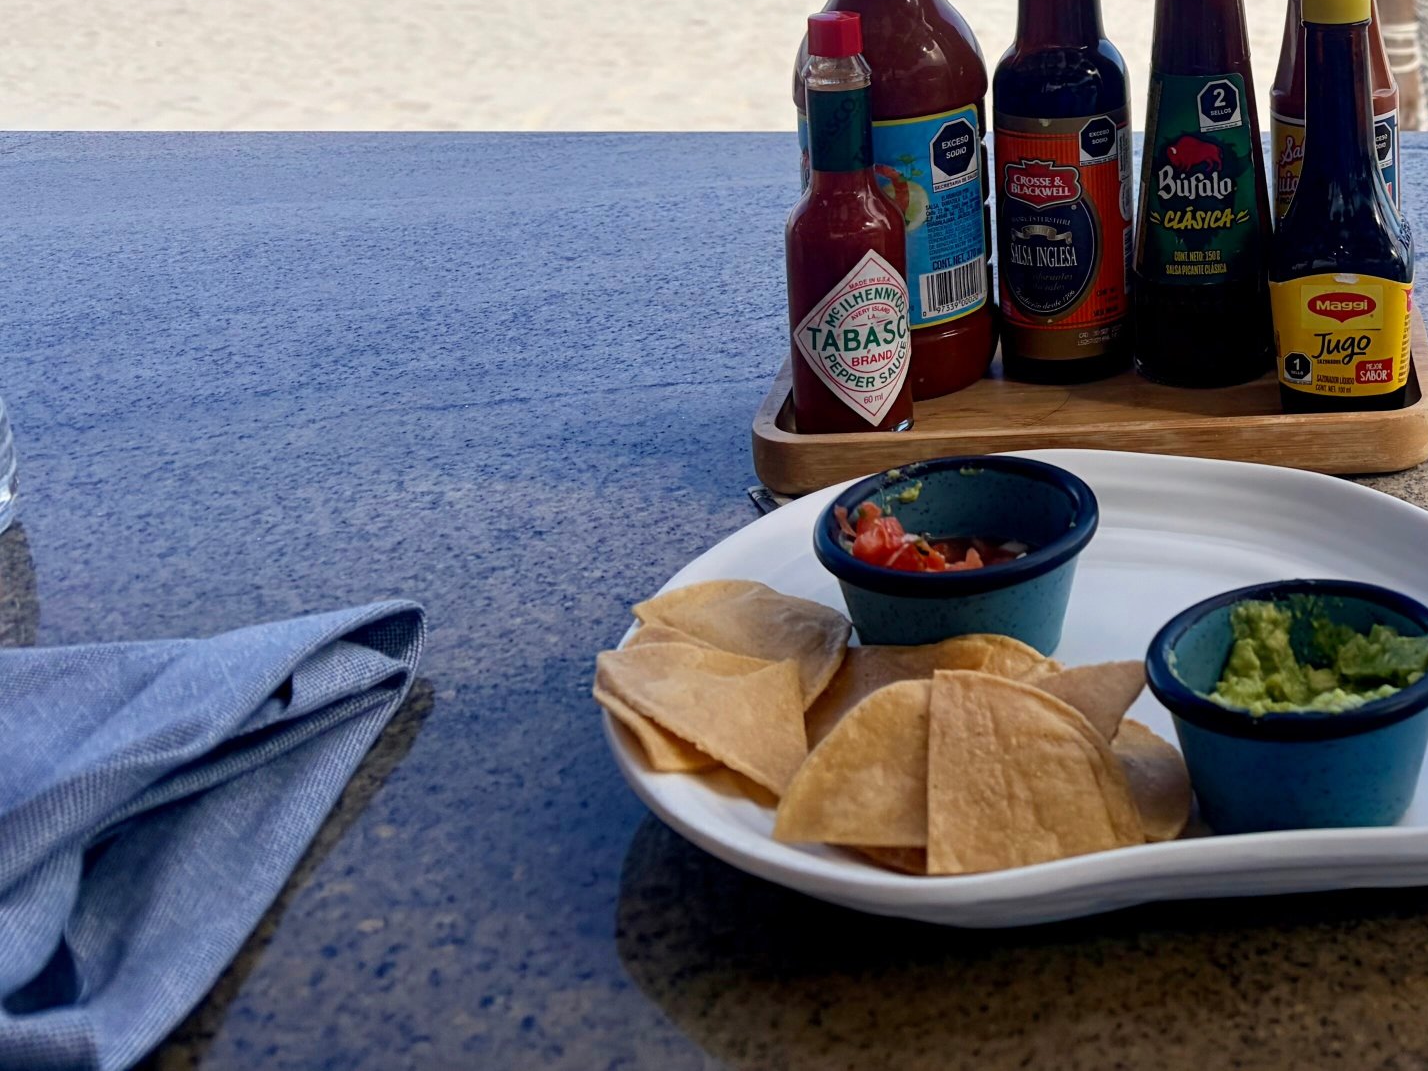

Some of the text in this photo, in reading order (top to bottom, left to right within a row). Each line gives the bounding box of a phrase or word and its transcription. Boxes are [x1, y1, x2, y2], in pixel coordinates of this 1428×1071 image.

[1213, 88, 1226, 107] 2
[1210, 108, 1232, 116] SELLOS
[1088, 129, 1110, 137] EXCESO
[1375, 134, 1388, 142] CESO
[941, 134, 969, 149] EXCESO
[945, 147, 967, 159] SODIO
[1013, 174, 1067, 187] CROSSE &
[1158, 165, 1233, 200] Búfalo
[1011, 183, 1071, 198] BLACKWELL
[1164, 206, 1235, 230] CLÁSICA
[1010, 242, 1078, 267] SALSA INGLESA
[1166, 261, 1228, 276] SALSA PICANTE CLÁSICA
[848, 278, 868, 290] MADE
[1316, 299, 1369, 311] Maggi
[851, 305, 891, 321] AVERY ISLAND
[807, 314, 908, 352] TABASC
[1311, 332, 1372, 366] Jugo
[824, 340, 907, 388] PEPPER SAUCE
[851, 349, 892, 367] BRAND
[1293, 358, 1300, 371] 1
[1365, 362, 1383, 370] MEJOR
[863, 393, 884, 404] 60 ml
